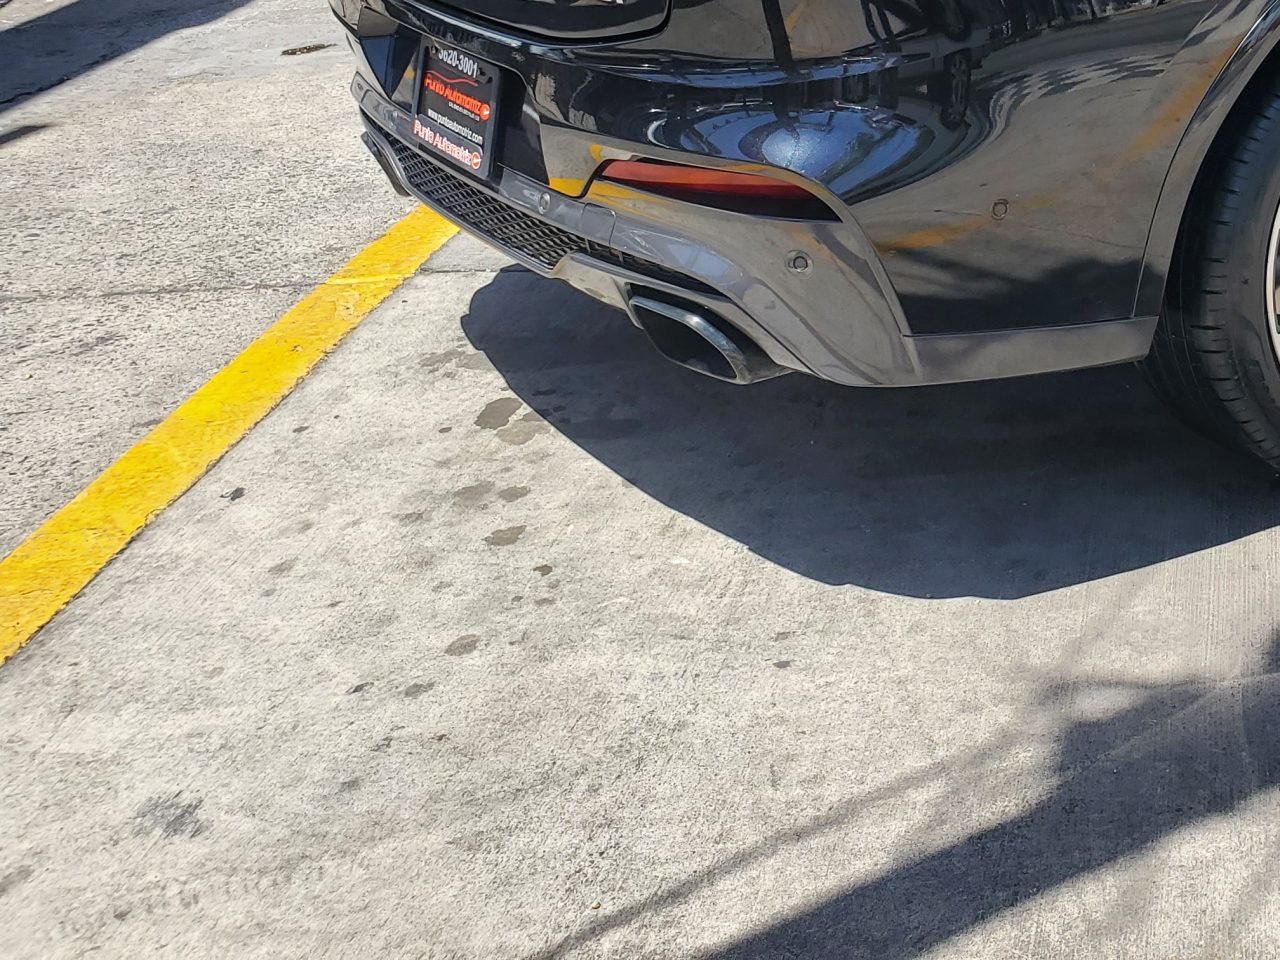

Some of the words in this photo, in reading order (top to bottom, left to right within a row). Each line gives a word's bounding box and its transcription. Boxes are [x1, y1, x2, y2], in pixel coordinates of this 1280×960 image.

[424, 73, 445, 96] Punto
[443, 86, 482, 115] Automotriz
[413, 120, 434, 145] Punto
[432, 134, 472, 167] Automotriz
[427, 108, 483, 145] www.puntoautomotriz.com
